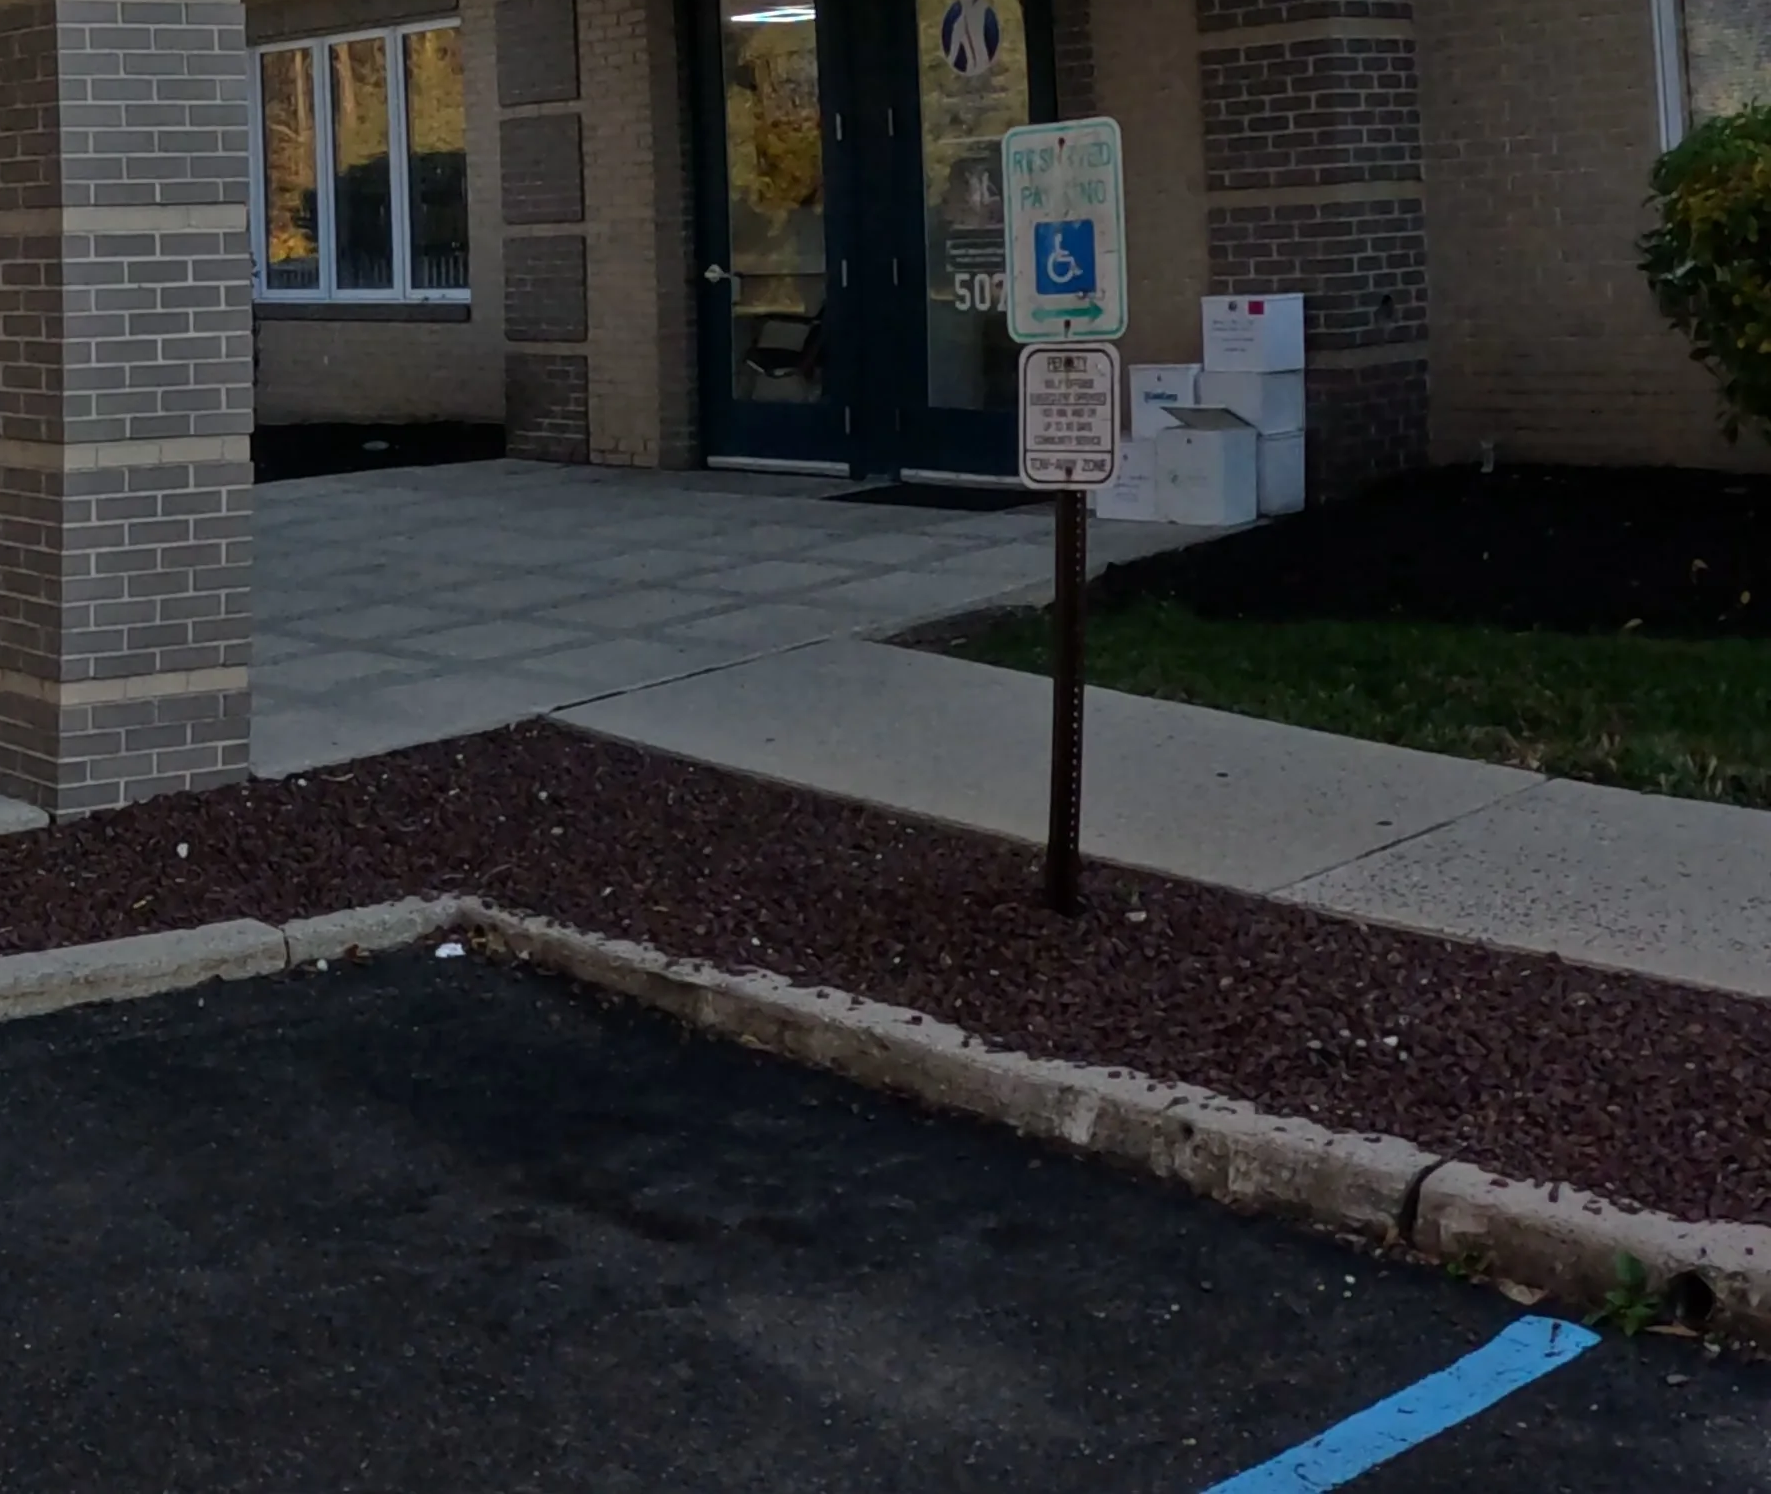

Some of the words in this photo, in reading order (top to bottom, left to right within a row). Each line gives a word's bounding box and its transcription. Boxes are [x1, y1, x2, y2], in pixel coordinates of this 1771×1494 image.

[1013, 142, 1110, 174] RESED
[1020, 179, 1106, 211] PANG
[1047, 356, 1088, 370] PENTY
